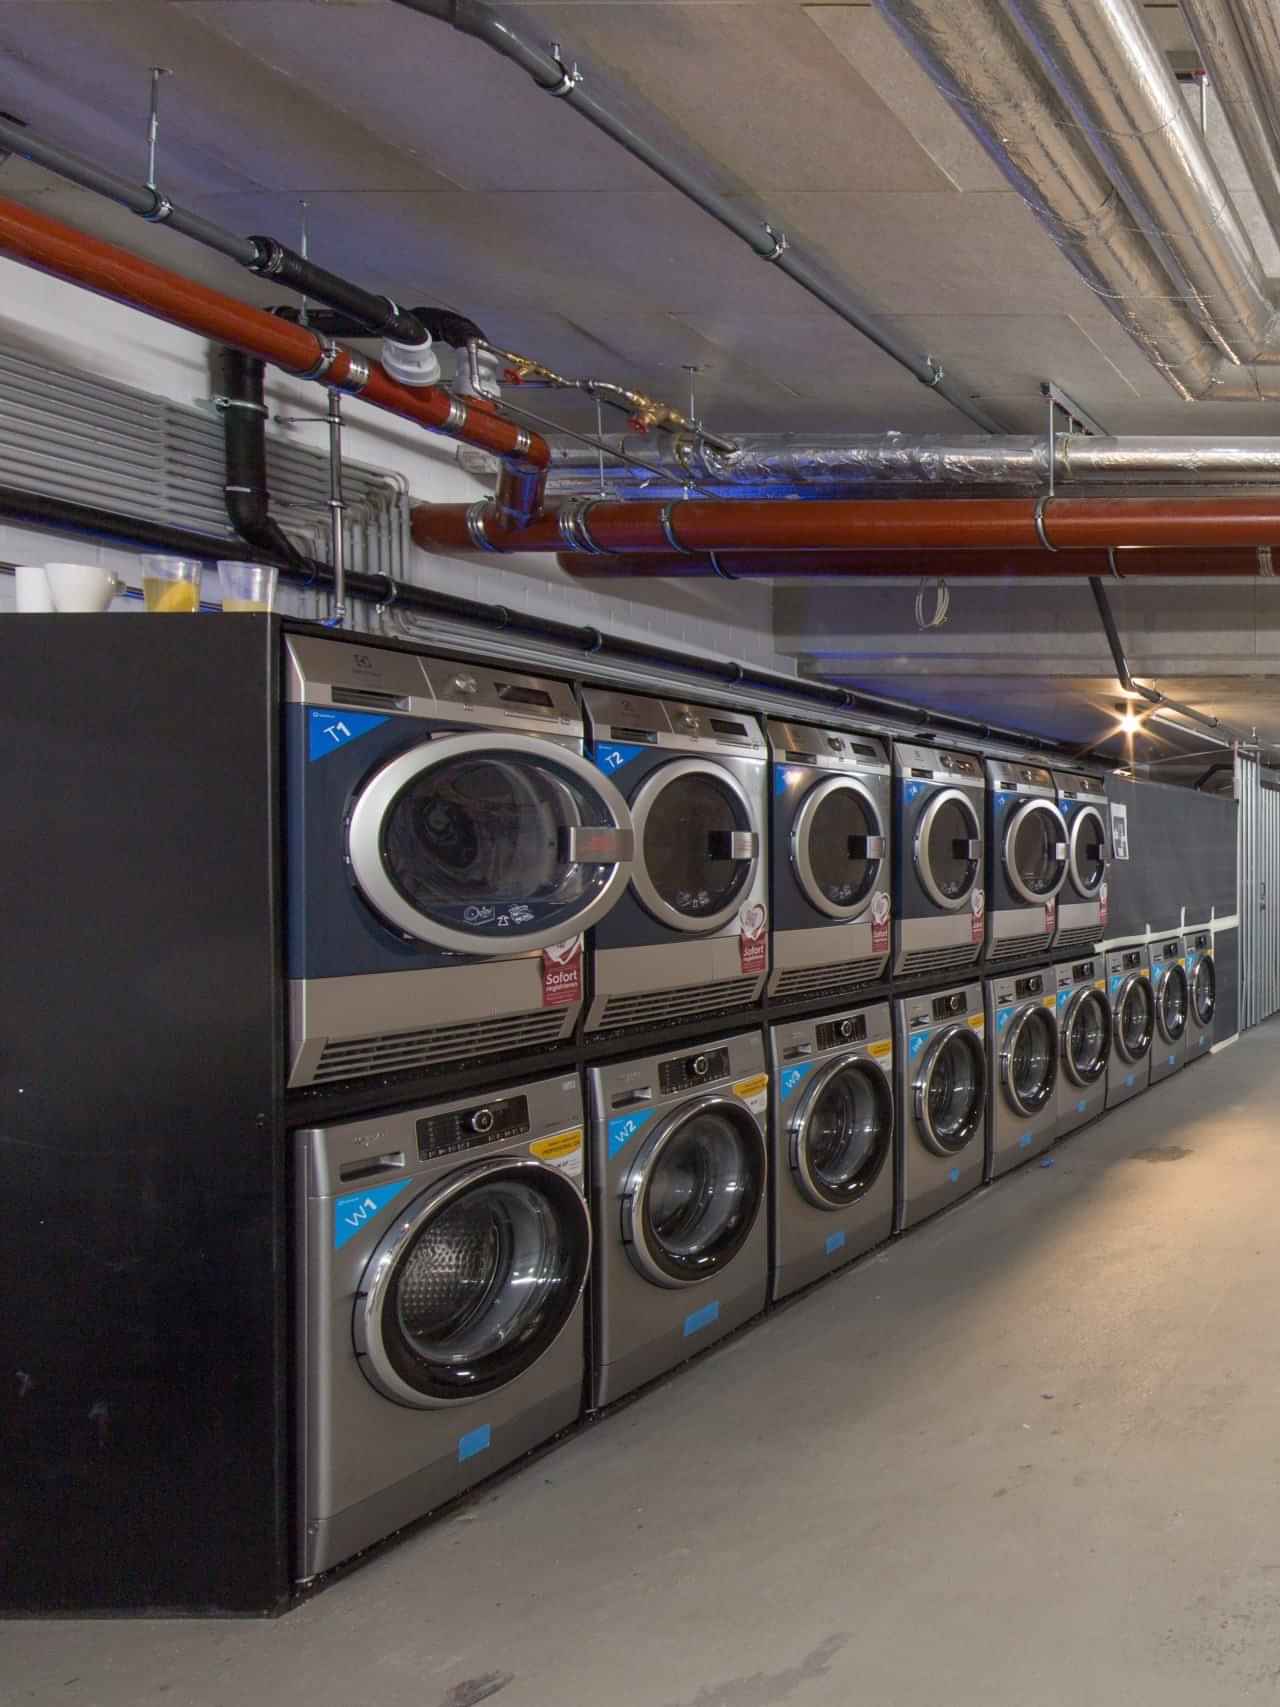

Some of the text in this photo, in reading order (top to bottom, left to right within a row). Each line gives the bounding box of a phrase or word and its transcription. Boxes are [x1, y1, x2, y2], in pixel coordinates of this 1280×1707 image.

[323, 721, 352, 743] T1
[605, 751, 624, 769] T2
[545, 969, 578, 985] Sofort
[614, 1119, 637, 1143] W2
[345, 1197, 377, 1227] W1
